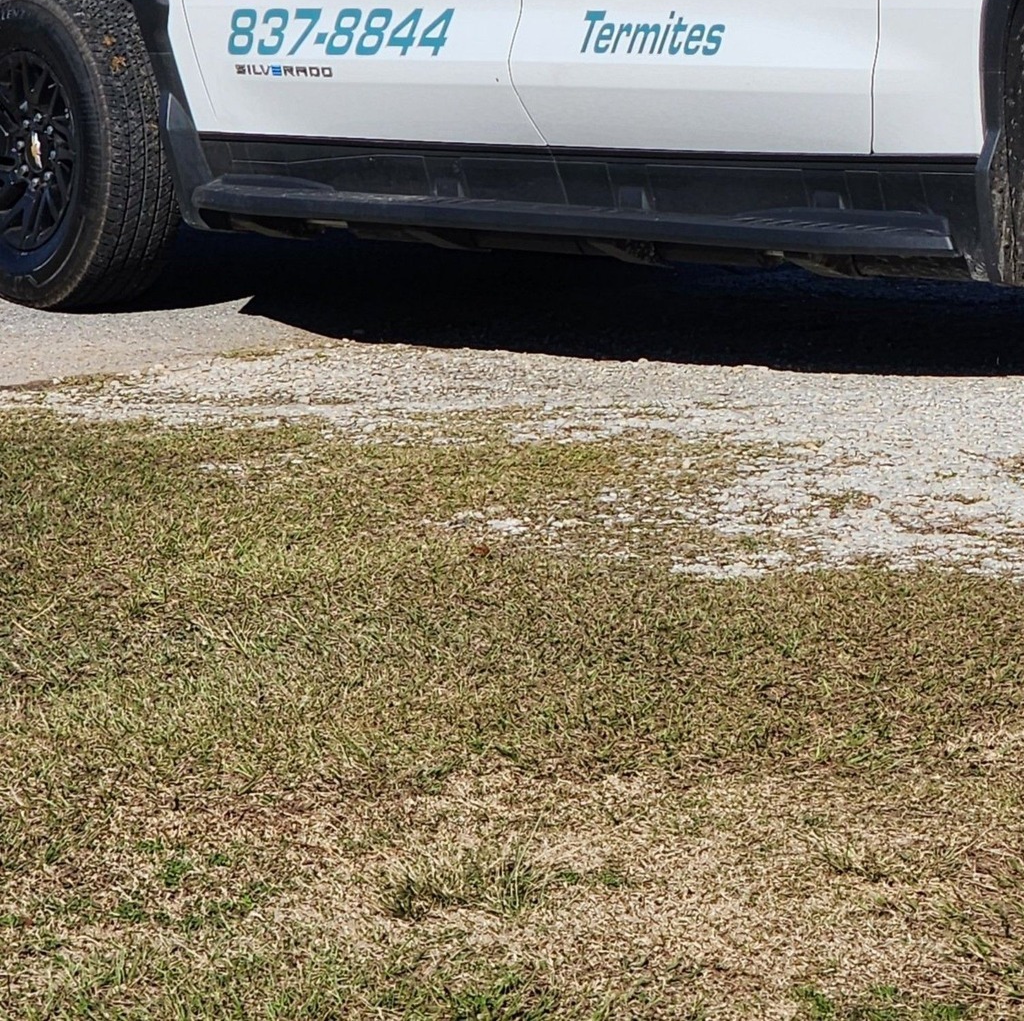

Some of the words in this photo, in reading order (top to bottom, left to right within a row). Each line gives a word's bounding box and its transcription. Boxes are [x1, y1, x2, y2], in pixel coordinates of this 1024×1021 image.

[227, 8, 455, 56] 837-8844
[580, 10, 726, 56] Termites
[235, 64, 333, 78] SILVERADO
